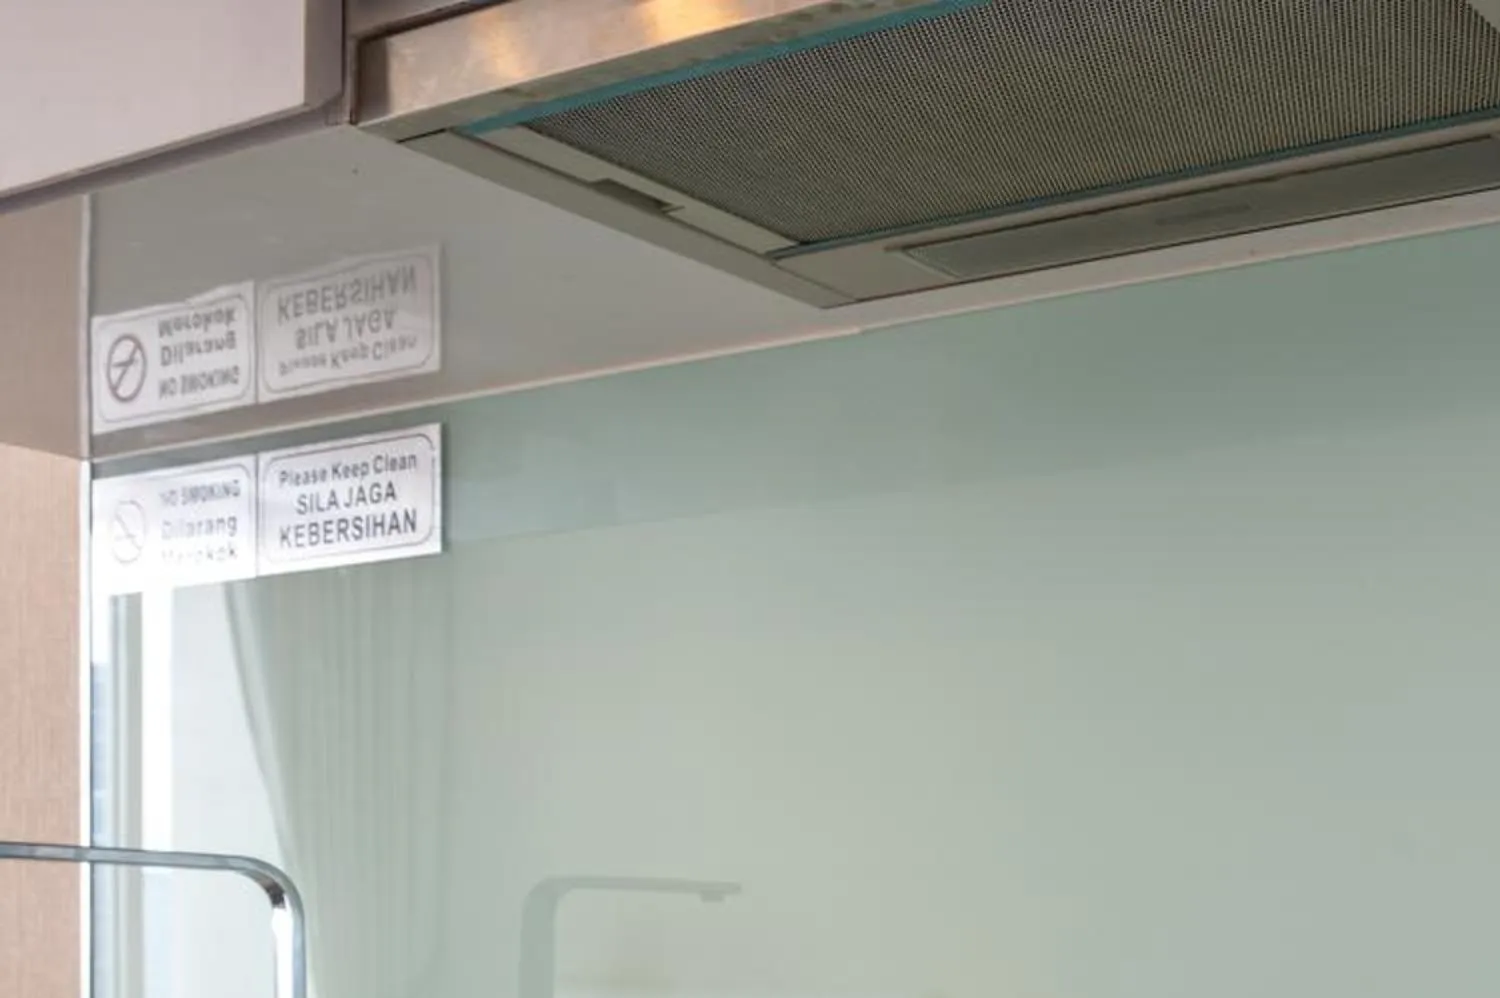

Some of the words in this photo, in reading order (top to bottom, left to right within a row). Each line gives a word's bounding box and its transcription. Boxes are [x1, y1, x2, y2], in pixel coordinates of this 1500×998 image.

[279, 468, 327, 487] Please
[331, 461, 369, 480] Keep
[372, 453, 417, 474] Clean
[296, 489, 339, 515] SILA
[344, 481, 396, 508] JAGA
[279, 509, 417, 548] KEBERSIHAN
